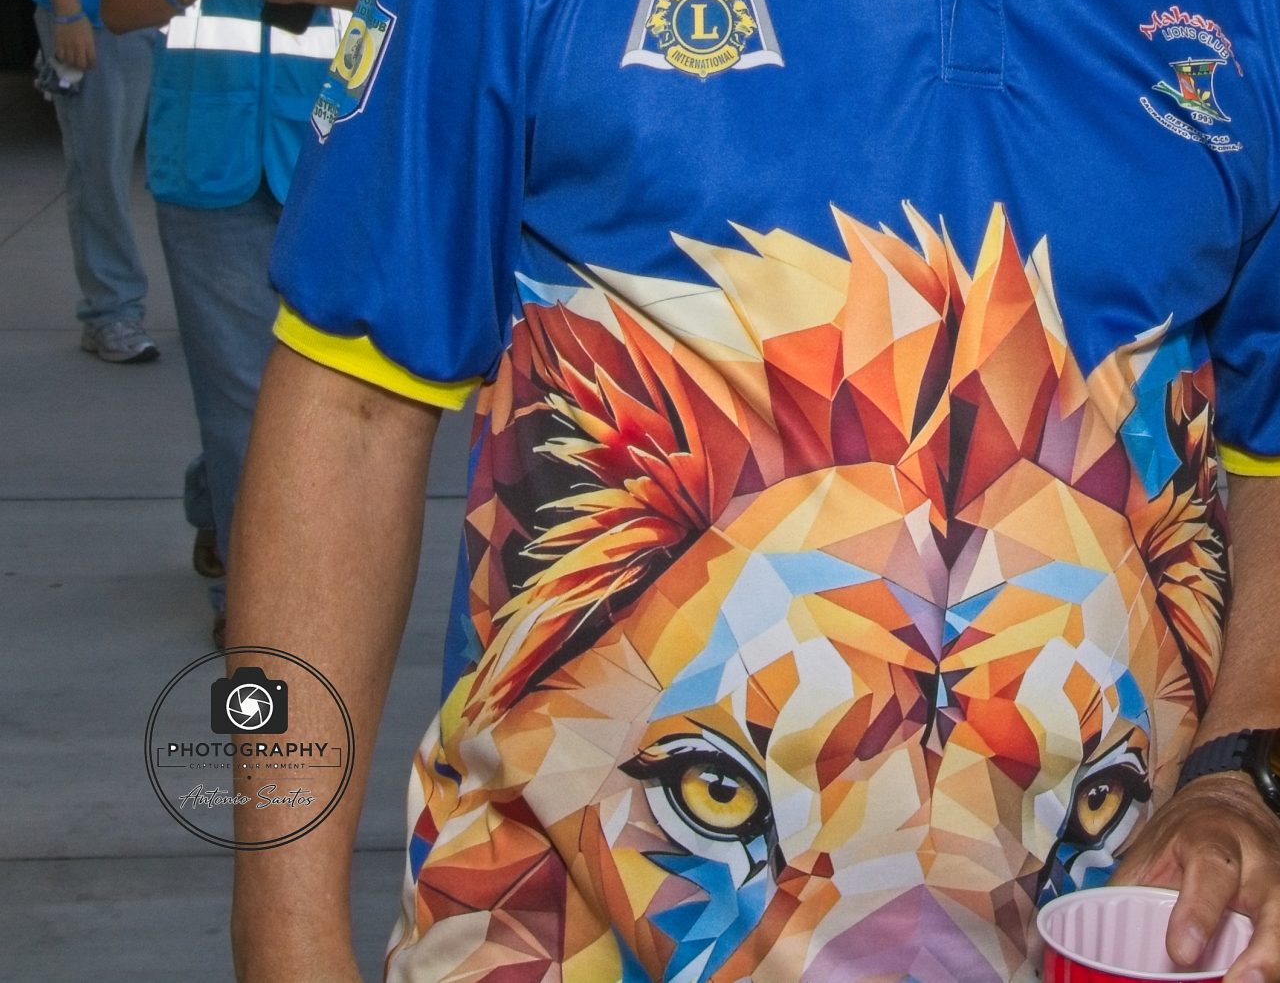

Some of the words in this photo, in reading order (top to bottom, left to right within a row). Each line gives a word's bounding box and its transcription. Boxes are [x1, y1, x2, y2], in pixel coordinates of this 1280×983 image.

[690, 3, 720, 40] L
[671, 49, 735, 69] INTERNATIONAL
[1162, 26, 1197, 42] LIONS
[1198, 31, 1230, 60] CLUB
